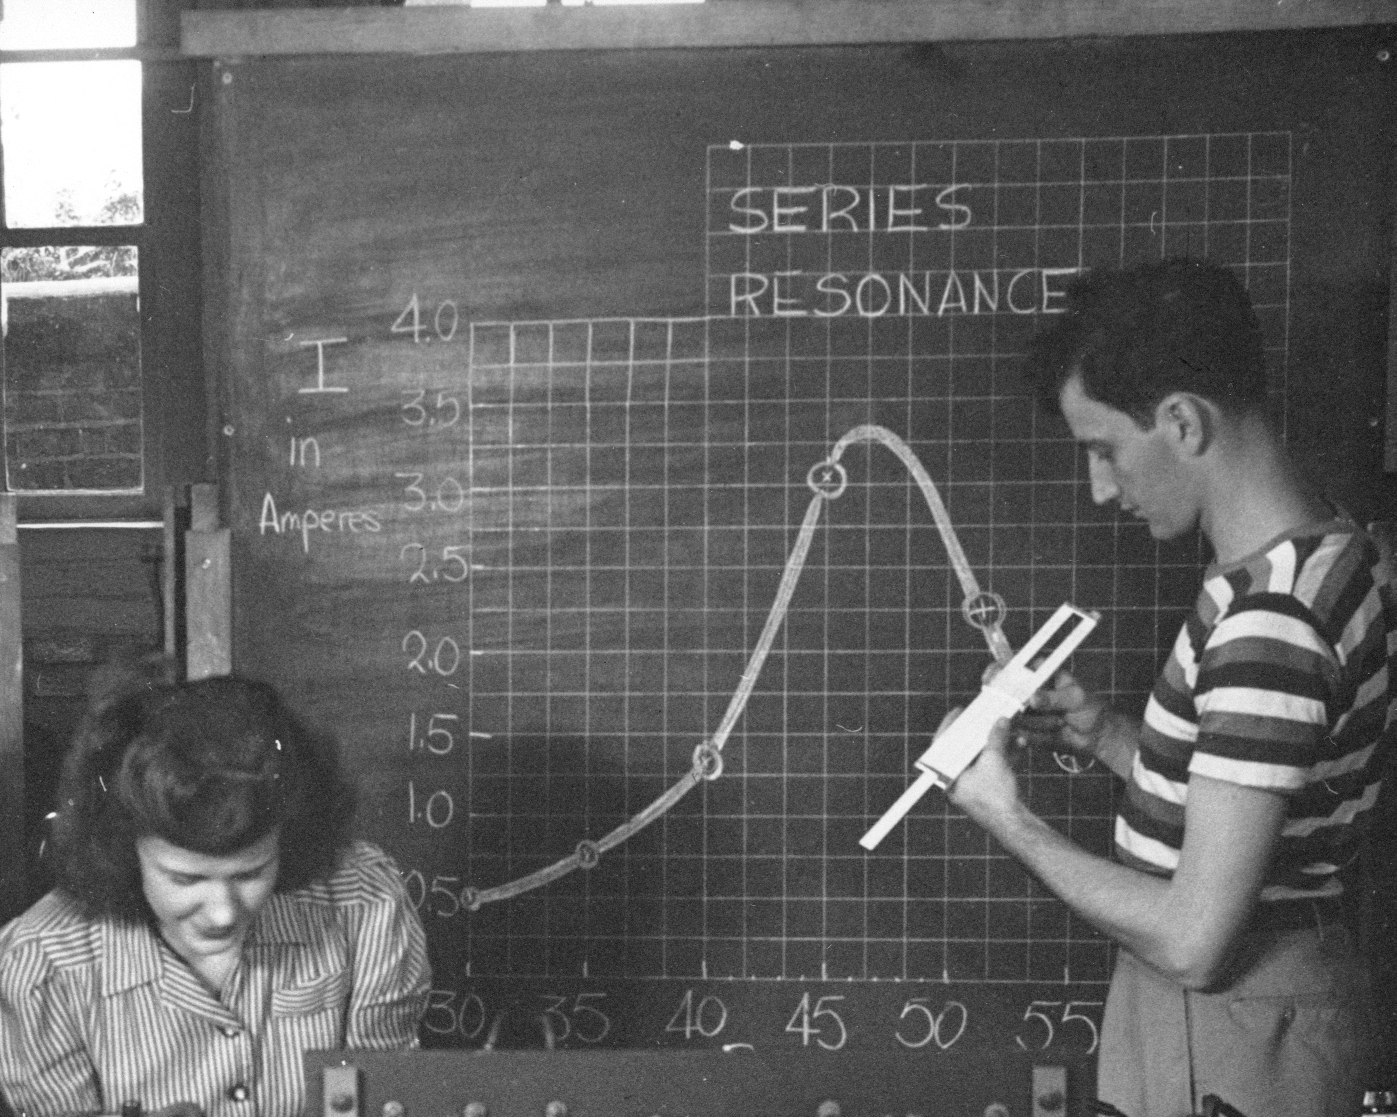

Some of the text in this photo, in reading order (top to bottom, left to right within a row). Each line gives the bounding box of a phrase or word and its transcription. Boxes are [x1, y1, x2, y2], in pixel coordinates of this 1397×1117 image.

[729, 184, 972, 232] SERIES
[730, 268, 1080, 317] RESONANCE
[391, 293, 459, 342] 4.0
[299, 337, 348, 393] I
[286, 416, 320, 467] in
[395, 472, 464, 512] 3.0
[259, 491, 381, 553] Amperes
[400, 543, 470, 583] 2.5
[402, 630, 459, 676] 2.0
[408, 713, 458, 754] 1.5
[408, 780, 453, 828] 1.0
[424, 989, 1103, 1055] 30 35 40 45 50 55
